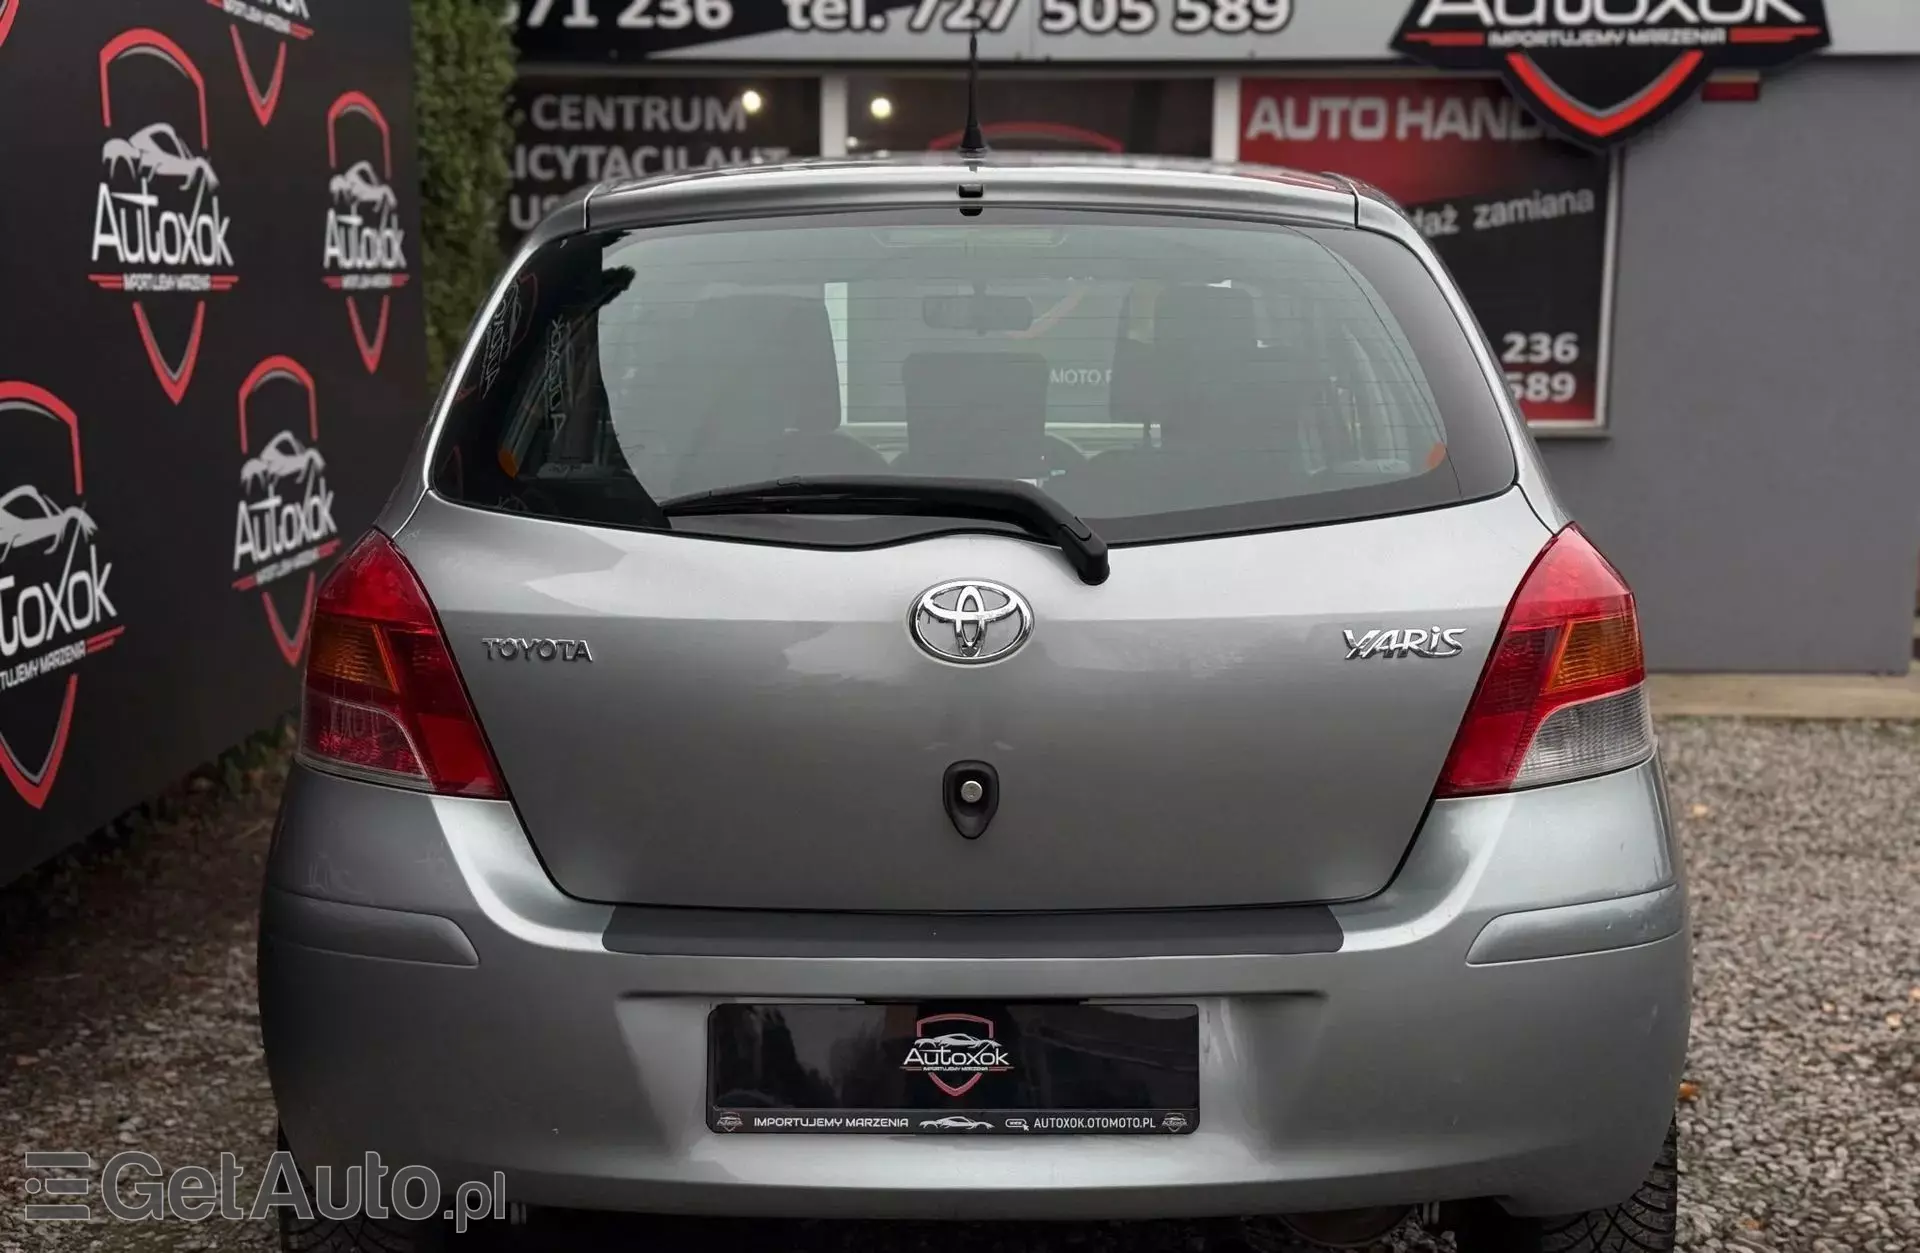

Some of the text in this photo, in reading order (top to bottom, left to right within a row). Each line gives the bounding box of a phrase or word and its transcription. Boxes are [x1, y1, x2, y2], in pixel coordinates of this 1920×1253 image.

[617, 0, 733, 29] 236
[784, 0, 886, 30] tel.
[1042, 0, 1155, 31] 505
[1176, 0, 1292, 31] 589
[531, 94, 747, 131] CENTRUM
[1246, 97, 1387, 141] AUTO
[1473, 190, 1595, 229] zamiana
[1502, 332, 1579, 363] 236
[482, 637, 593, 662] TOYOTA
[754, 1117, 909, 1128] IMPORTUJEMY MARZENIA
[1033, 1117, 1156, 1129] AUTOXOK.OTOMOTO.PL
